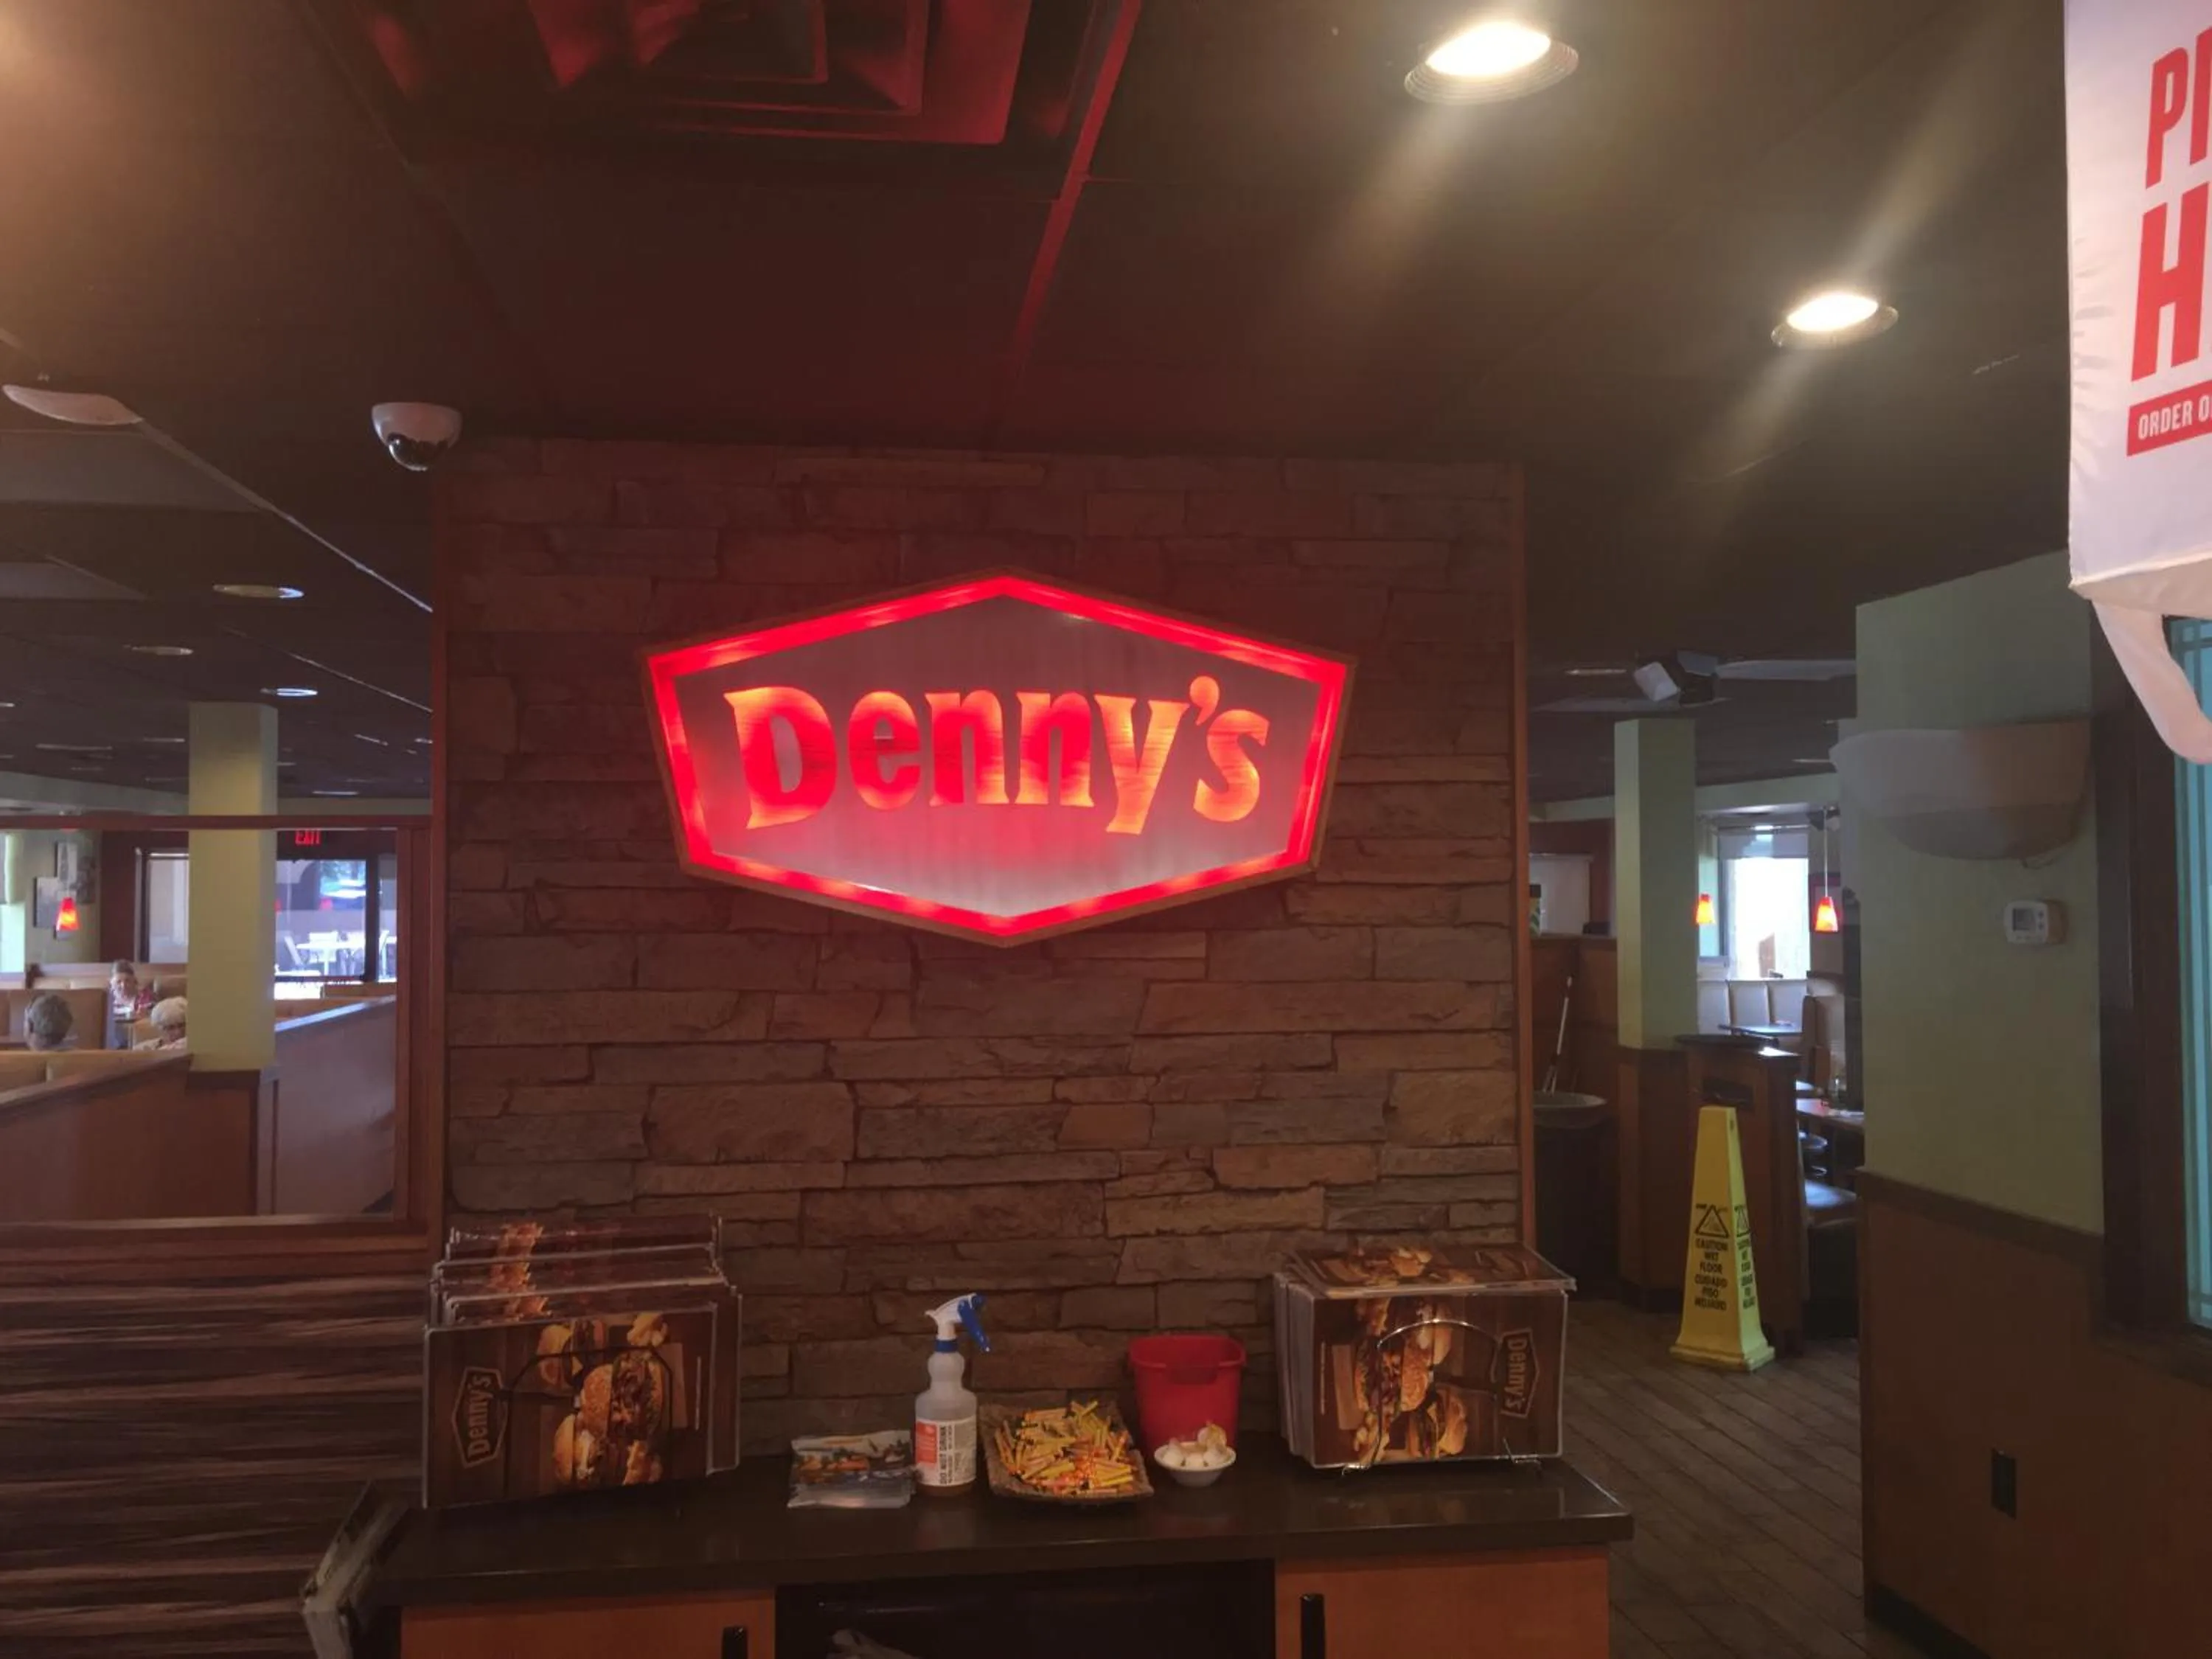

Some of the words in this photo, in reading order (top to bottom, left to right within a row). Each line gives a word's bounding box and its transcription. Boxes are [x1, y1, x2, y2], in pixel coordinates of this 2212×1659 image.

[2138, 400, 2193, 440] ORDER
[2198, 394, 2212, 422] O
[723, 675, 1270, 835] Denny's
[295, 830, 320, 845] EXIT
[1696, 1238, 1728, 1251] CAUTION
[1705, 1252, 1719, 1262] WET
[1700, 1262, 1722, 1274] FLOOR
[1505, 1339, 1527, 1410] Denny's
[468, 1375, 493, 1458] Denny's
